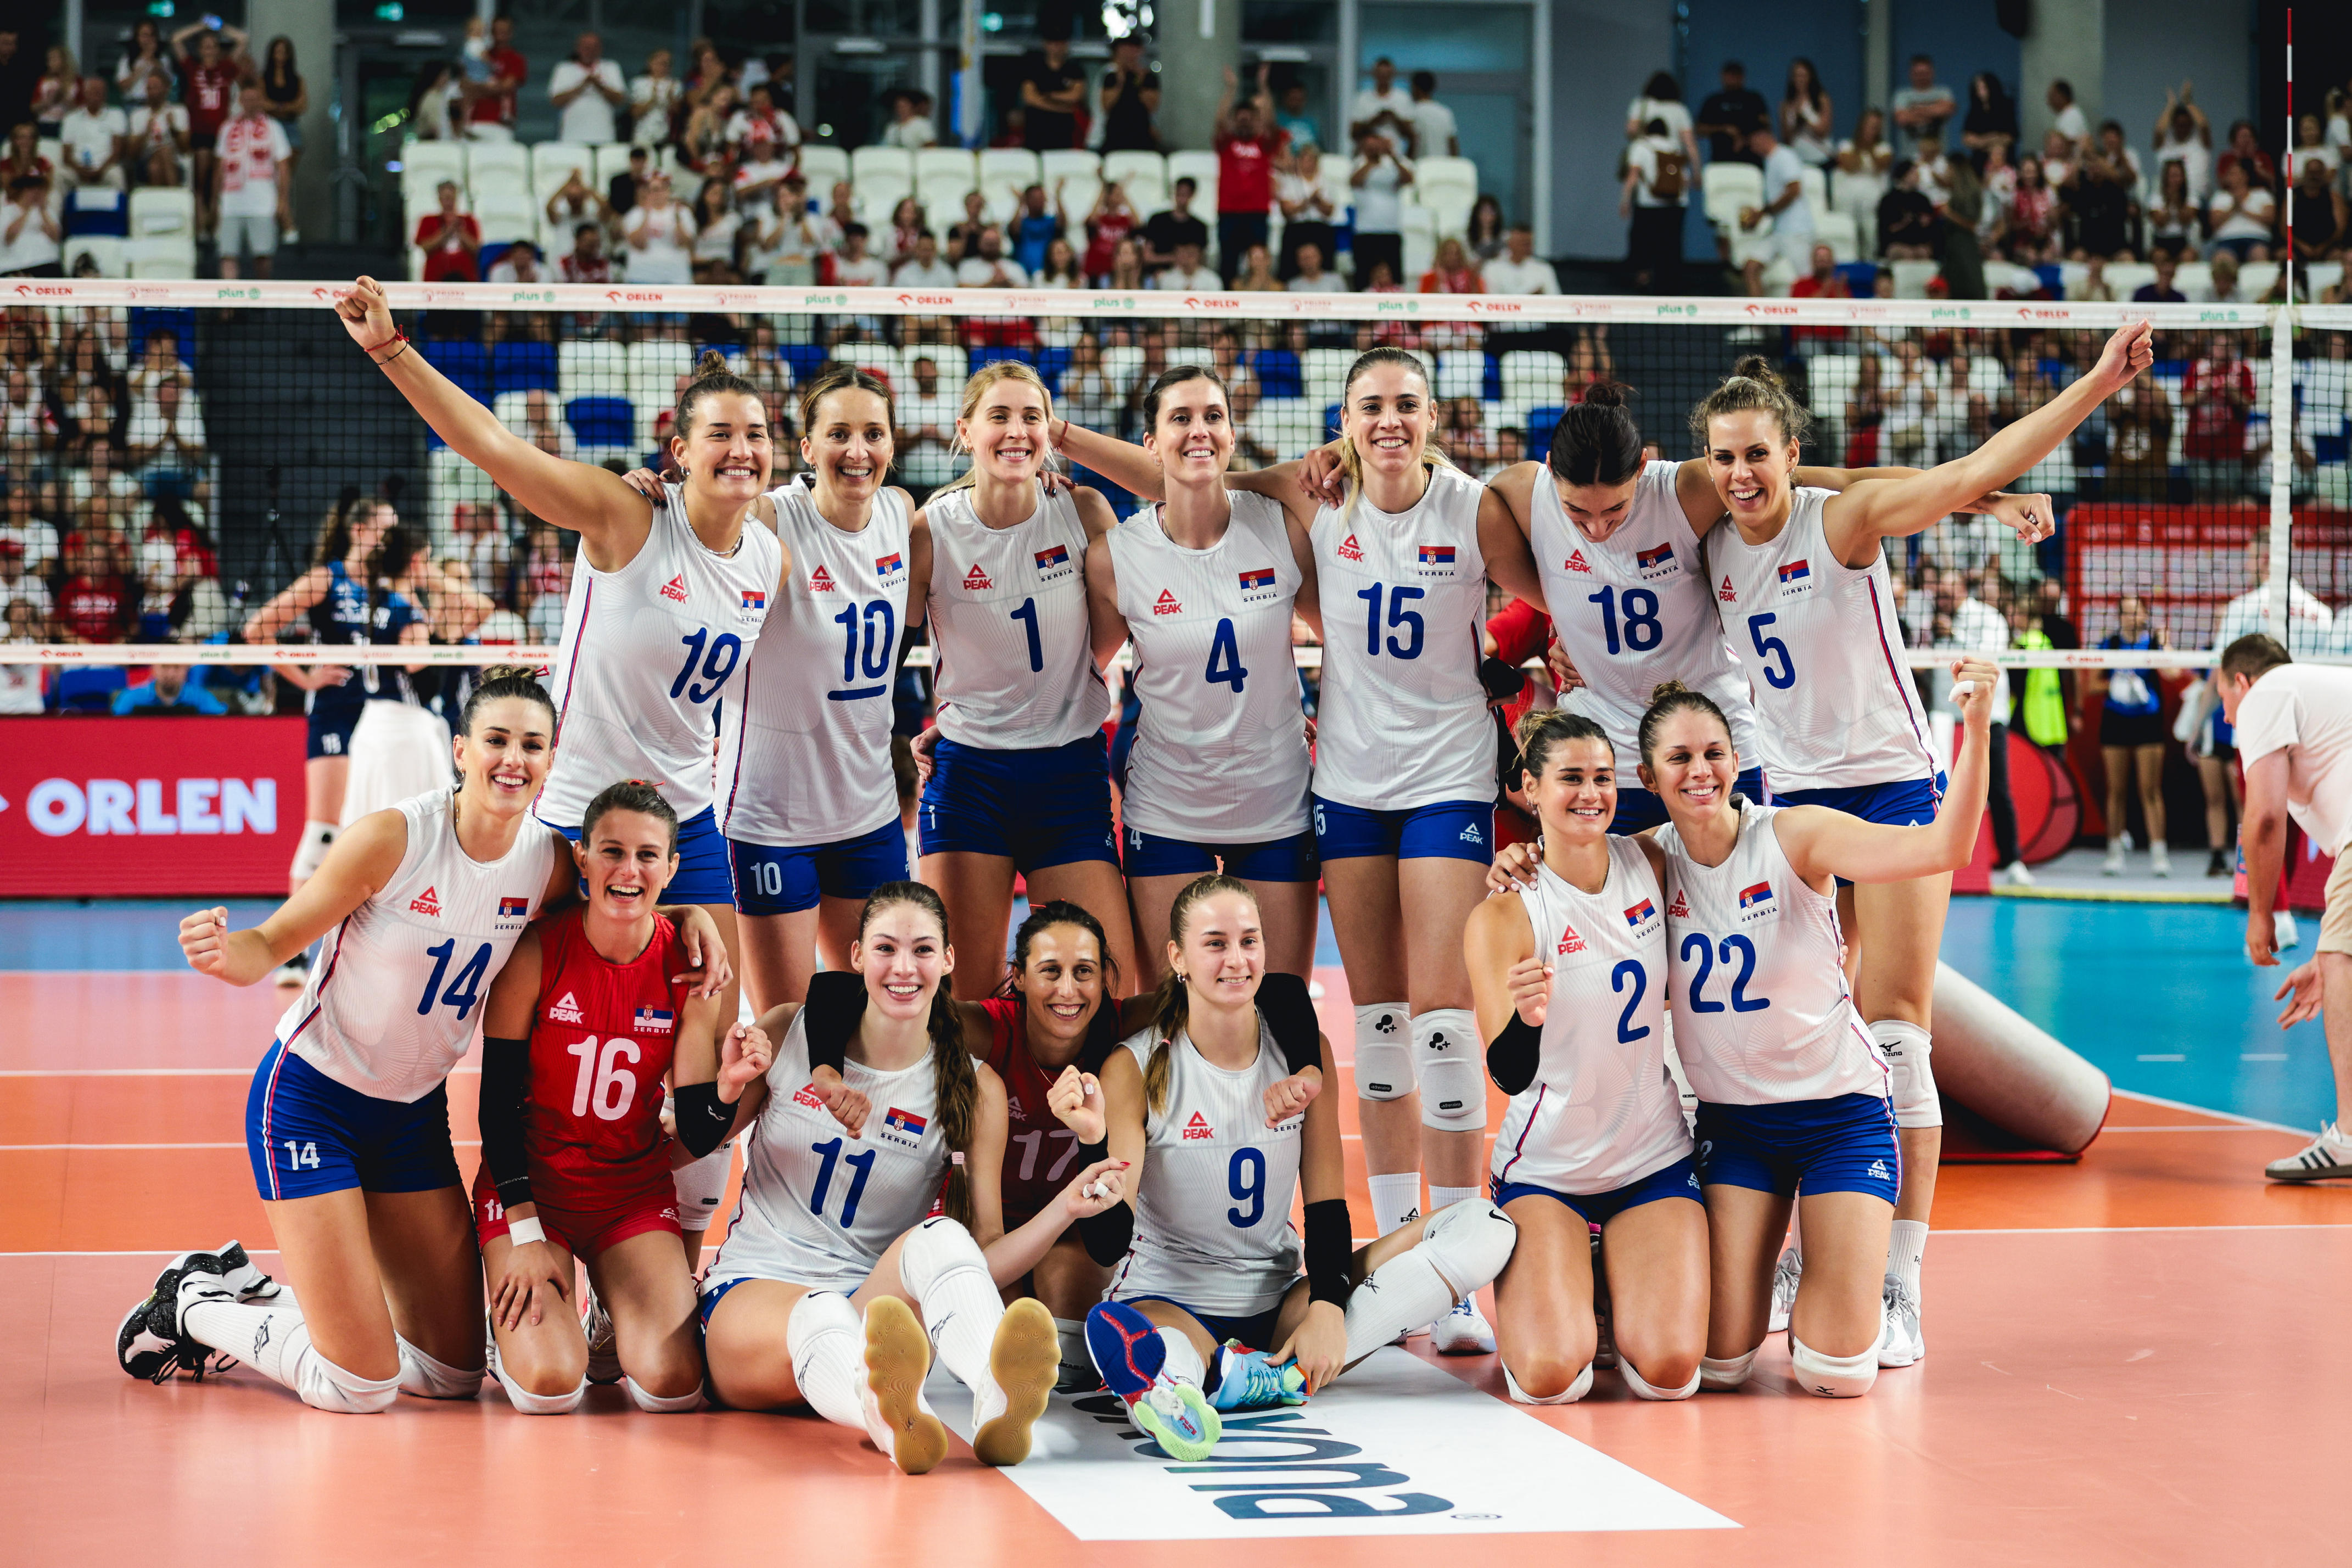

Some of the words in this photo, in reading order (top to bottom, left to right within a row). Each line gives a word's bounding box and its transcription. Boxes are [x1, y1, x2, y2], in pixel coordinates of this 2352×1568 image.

[35, 287, 72, 295] ORLEN
[217, 287, 245, 299] plus
[513, 290, 539, 303] plus
[626, 294, 663, 302] ORLEN
[805, 294, 831, 306] plus
[917, 296, 953, 305] ORLEN
[1094, 297, 1120, 309] plus
[1204, 300, 1239, 308] ORLEN
[1379, 300, 1404, 311] plus
[1486, 304, 1521, 312] ORLEN
[1657, 304, 1682, 315] plus
[1763, 306, 1798, 315] ORLEN
[1931, 307, 1956, 319] plus
[2035, 310, 2070, 318] ORLEN
[2199, 311, 2225, 322] plus
[1337, 545, 1365, 563] PEAK
[1564, 560, 1592, 574] PEAK
[1643, 565, 1679, 580] SERBIA
[881, 576, 906, 589] SERBIA
[1041, 569, 1073, 582] SERBIA
[809, 580, 836, 592] PEAK
[962, 578, 993, 590] PEAK
[1782, 584, 1812, 597] SERBIA
[659, 585, 690, 604] PEAK
[1243, 593, 1277, 602] SERBIA
[1719, 590, 1738, 603] PEAK
[1153, 603, 1183, 615] PEAK
[1357, 581, 1425, 660] 15
[1588, 585, 1664, 655] 18
[834, 600, 894, 683] 10
[1010, 597, 1044, 673] 1
[1205, 618, 1248, 693] 4
[1748, 612, 1796, 690] 5
[670, 627, 742, 704] 19
[26, 777, 277, 837] ORLEN
[928, 805, 936, 830] 1
[1130, 828, 1143, 850] 4
[1459, 832, 1484, 845] PEAK
[750, 861, 782, 895] 10
[410, 899, 443, 919] PEAK
[1668, 904, 1691, 920] PEAK
[1741, 907, 1778, 923] SERBIA
[1636, 922, 1661, 940] SERBIA
[1558, 939, 1588, 956] PEAK
[417, 938, 494, 1021] 14
[1680, 932, 1771, 1013] 22
[1611, 959, 1650, 1044] 2
[549, 1010, 585, 1024] PEAK
[567, 1035, 641, 1121] 16
[792, 1092, 824, 1112] PEAK
[1009, 1109, 1028, 1121] EAK
[1183, 1127, 1216, 1140] PEAK
[880, 1132, 918, 1150] SERBIA
[284, 1140, 321, 1171] 14
[1012, 1128, 1079, 1181] 17
[1867, 1168, 1891, 1181] PEAK
[810, 1136, 877, 1229] 11
[1228, 1146, 1266, 1229] 9
